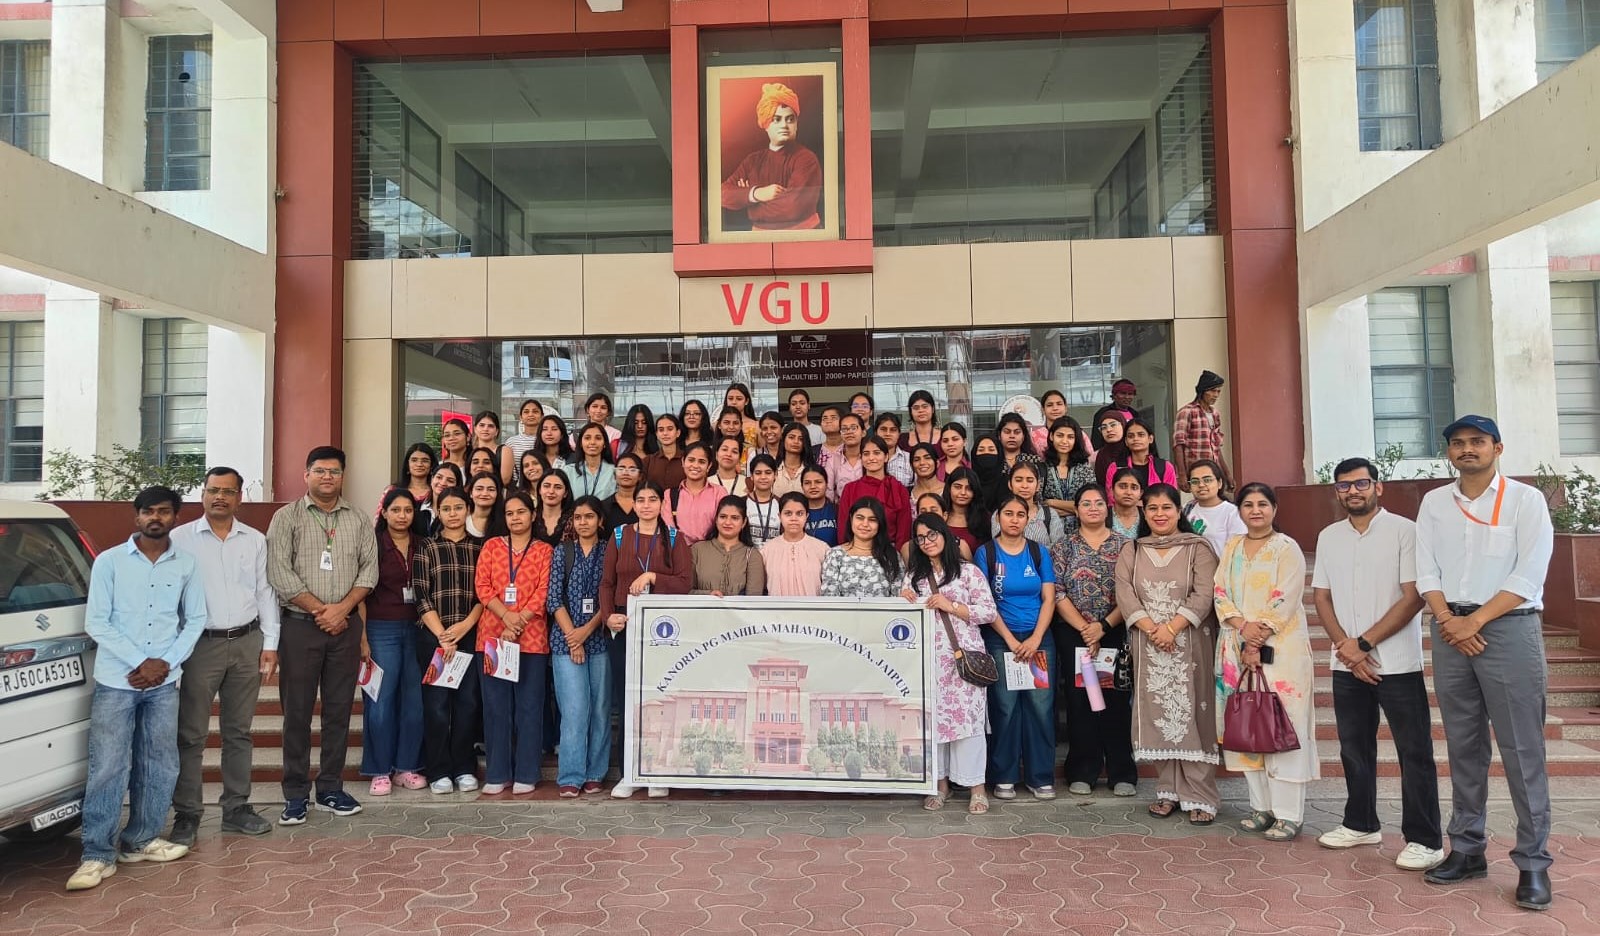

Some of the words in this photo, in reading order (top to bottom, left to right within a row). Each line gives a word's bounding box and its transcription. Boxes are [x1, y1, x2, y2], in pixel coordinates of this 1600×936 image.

[721, 281, 830, 326] VGU
[719, 361, 761, 371] DRMS
[810, 358, 853, 368] STORIES
[860, 356, 882, 366] ONE
[884, 354, 945, 366] UNIVERSITY
[3, 660, 80, 692] RJ60CA5319
[656, 648, 702, 693] KANORIA
[702, 637, 719, 652] PG
[720, 624, 768, 643] MAHILA
[875, 658, 910, 698] JAIPUR
[37, 802, 82, 825] WAGON
